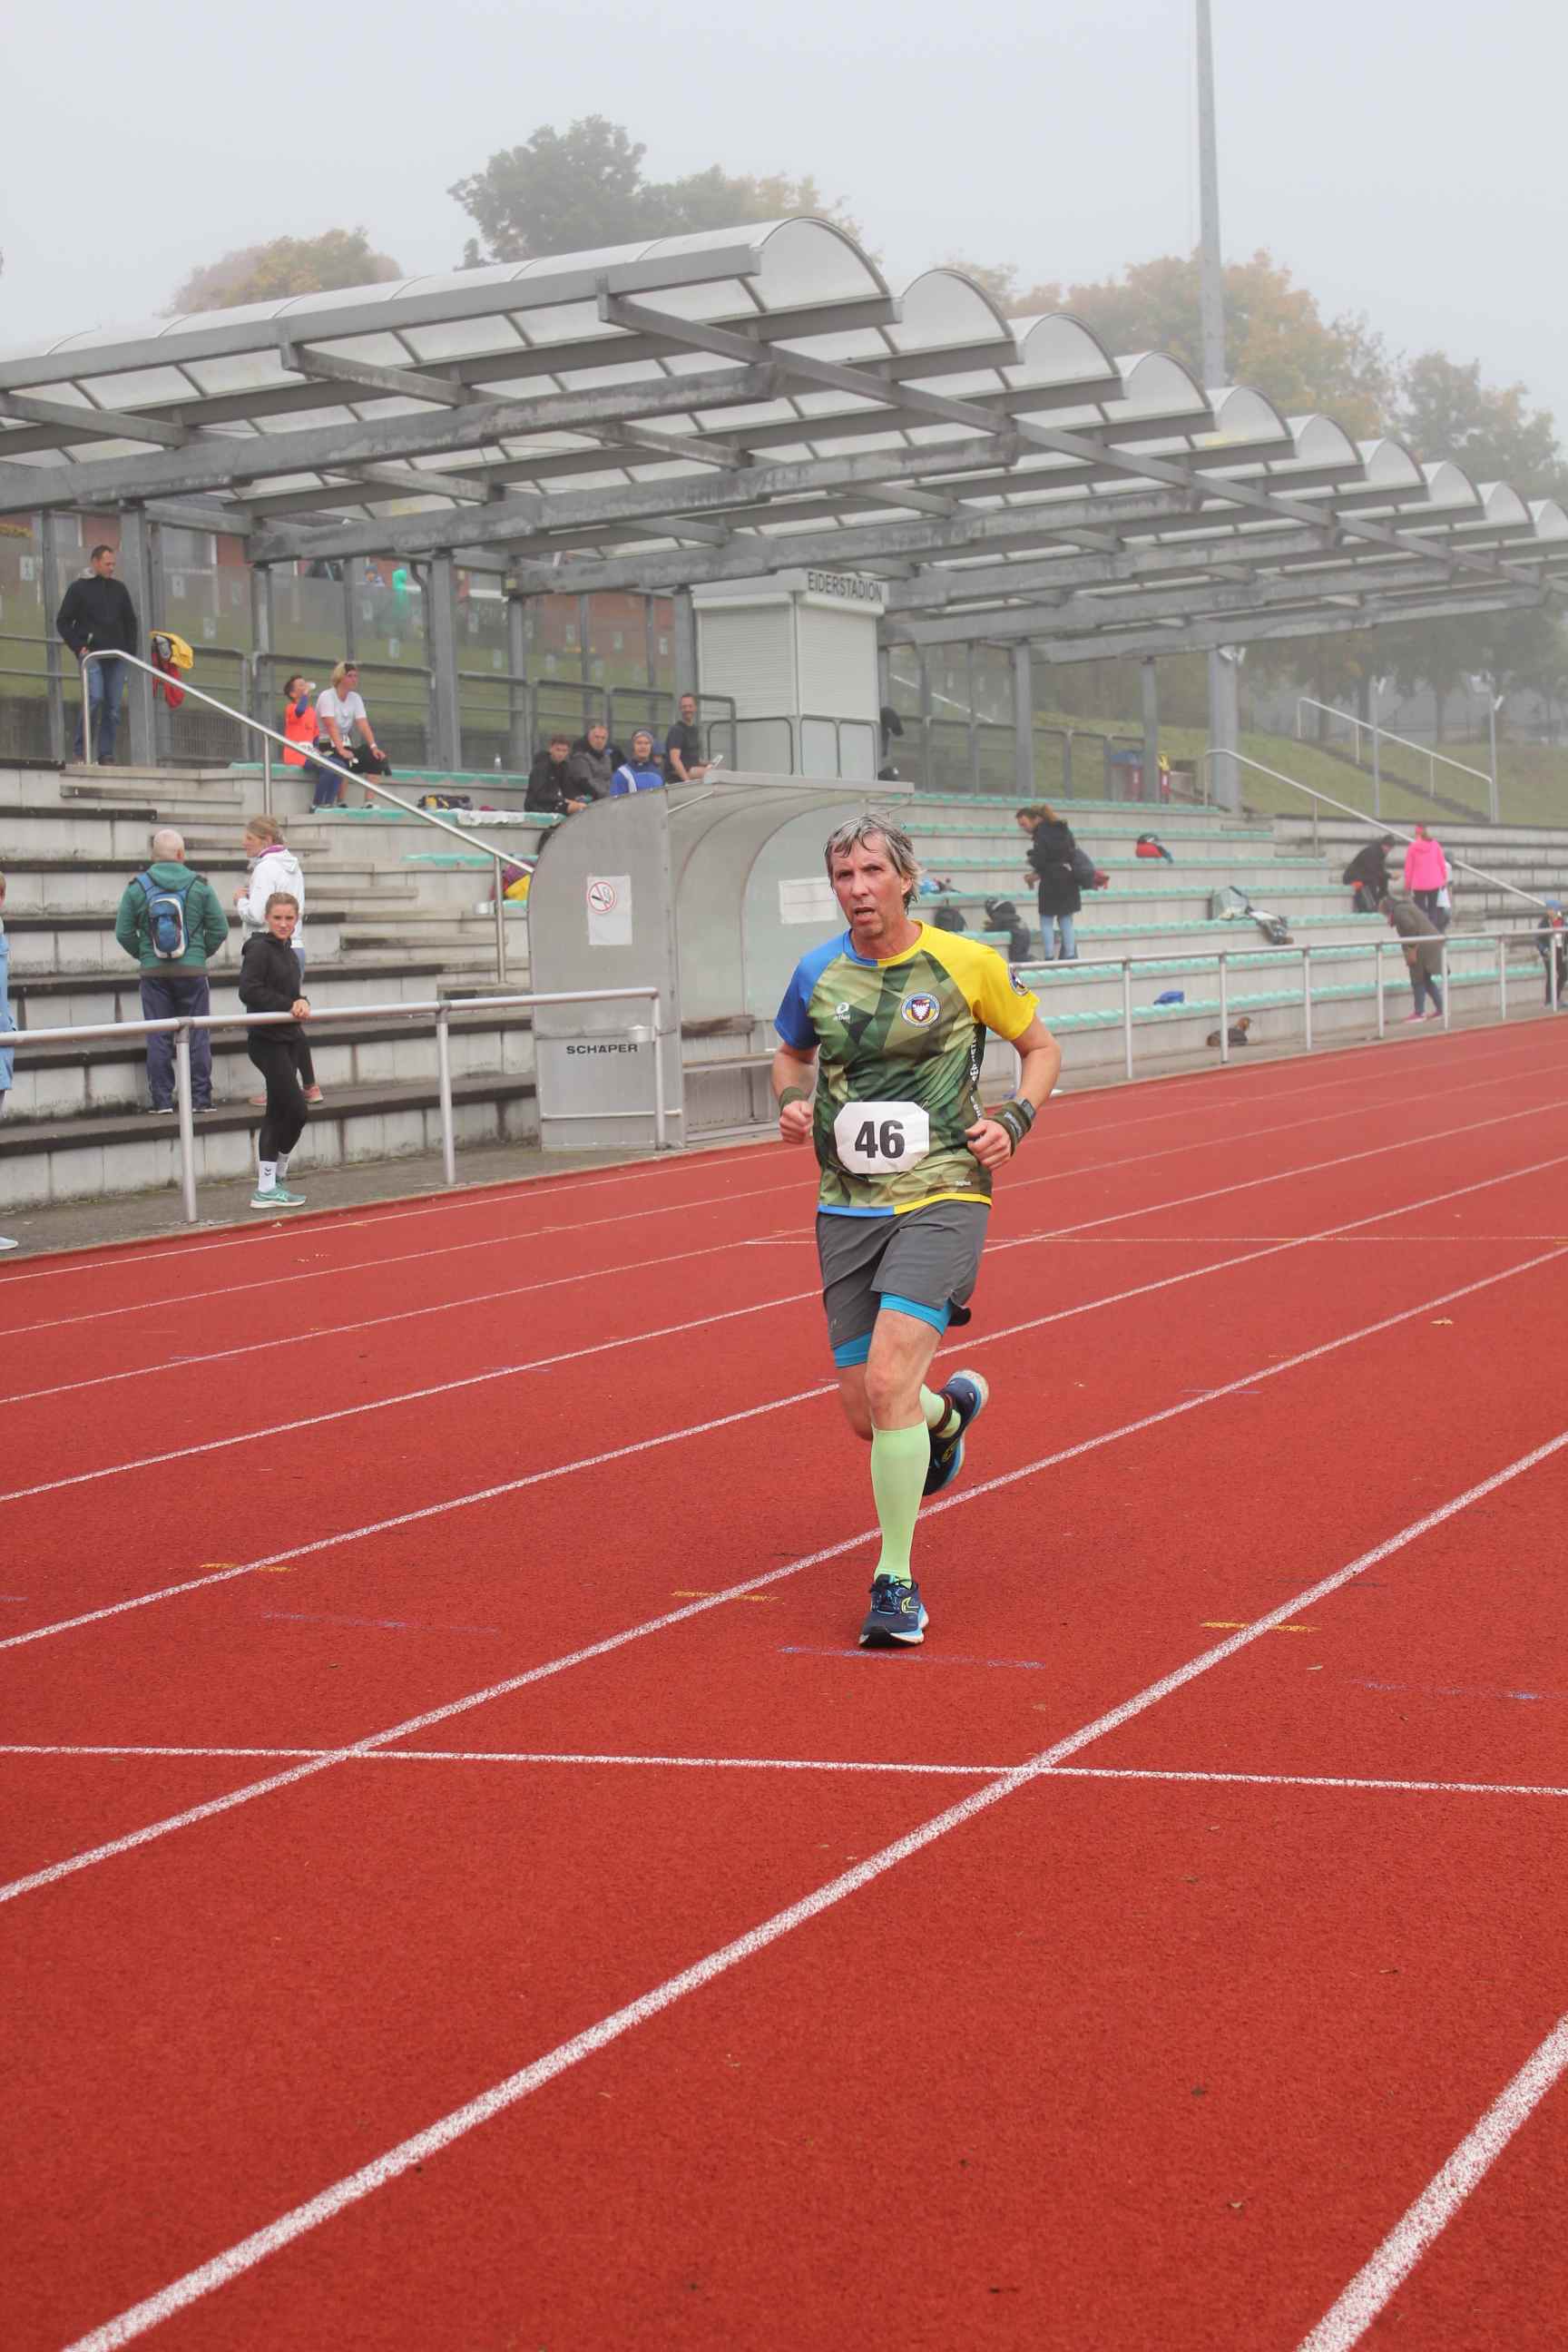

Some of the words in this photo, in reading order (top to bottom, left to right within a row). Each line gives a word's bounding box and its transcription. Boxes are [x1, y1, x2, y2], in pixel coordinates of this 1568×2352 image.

[807, 571, 883, 603] EIDERSTADION
[566, 1044, 638, 1054] SCHÄPER
[855, 1120, 906, 1159] 46
